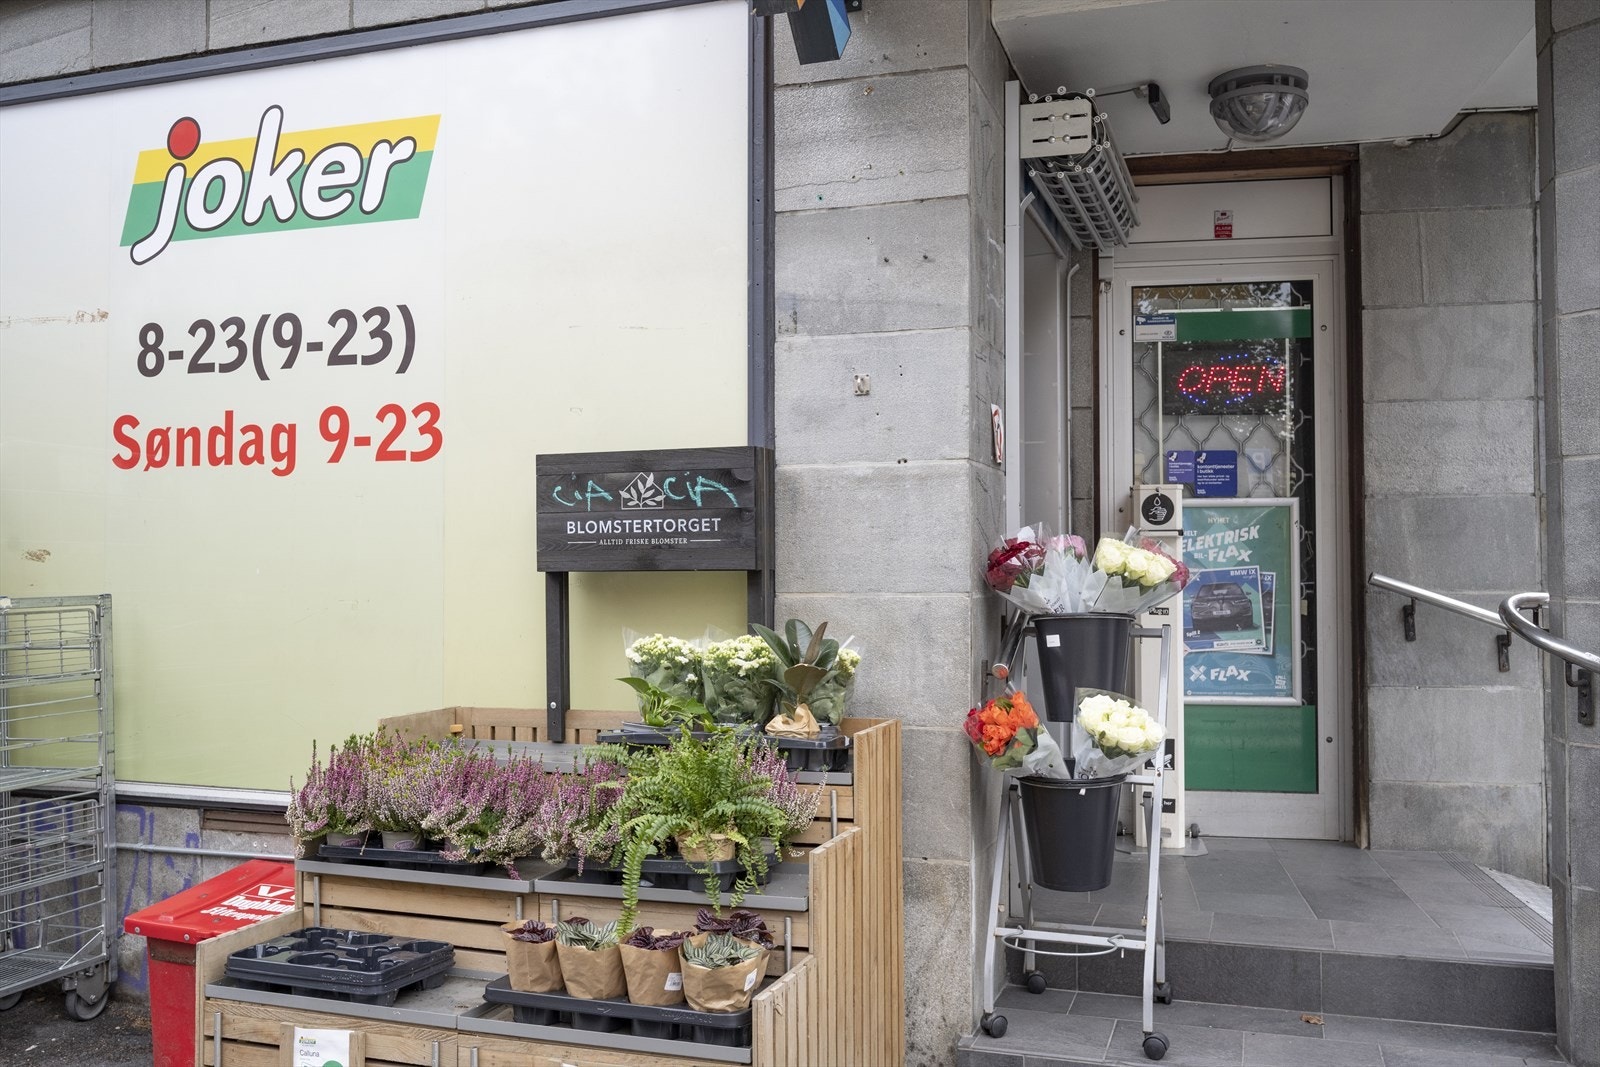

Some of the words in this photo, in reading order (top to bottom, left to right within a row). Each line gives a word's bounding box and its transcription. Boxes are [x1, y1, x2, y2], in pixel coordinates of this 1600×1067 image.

[130, 104, 417, 266] joker
[137, 304, 416, 381] 8-23(9-23)
[1178, 366, 1284, 392] OPEN
[112, 410, 297, 477] Søndag
[318, 401, 443, 464] 9-23
[567, 518, 721, 534] BLOMSTERTORGET
[651, 537, 688, 545] BLOMSTER
[1210, 665, 1251, 681] FLAX
[258, 885, 295, 901] V
[299, 1049, 320, 1058] Calluna
